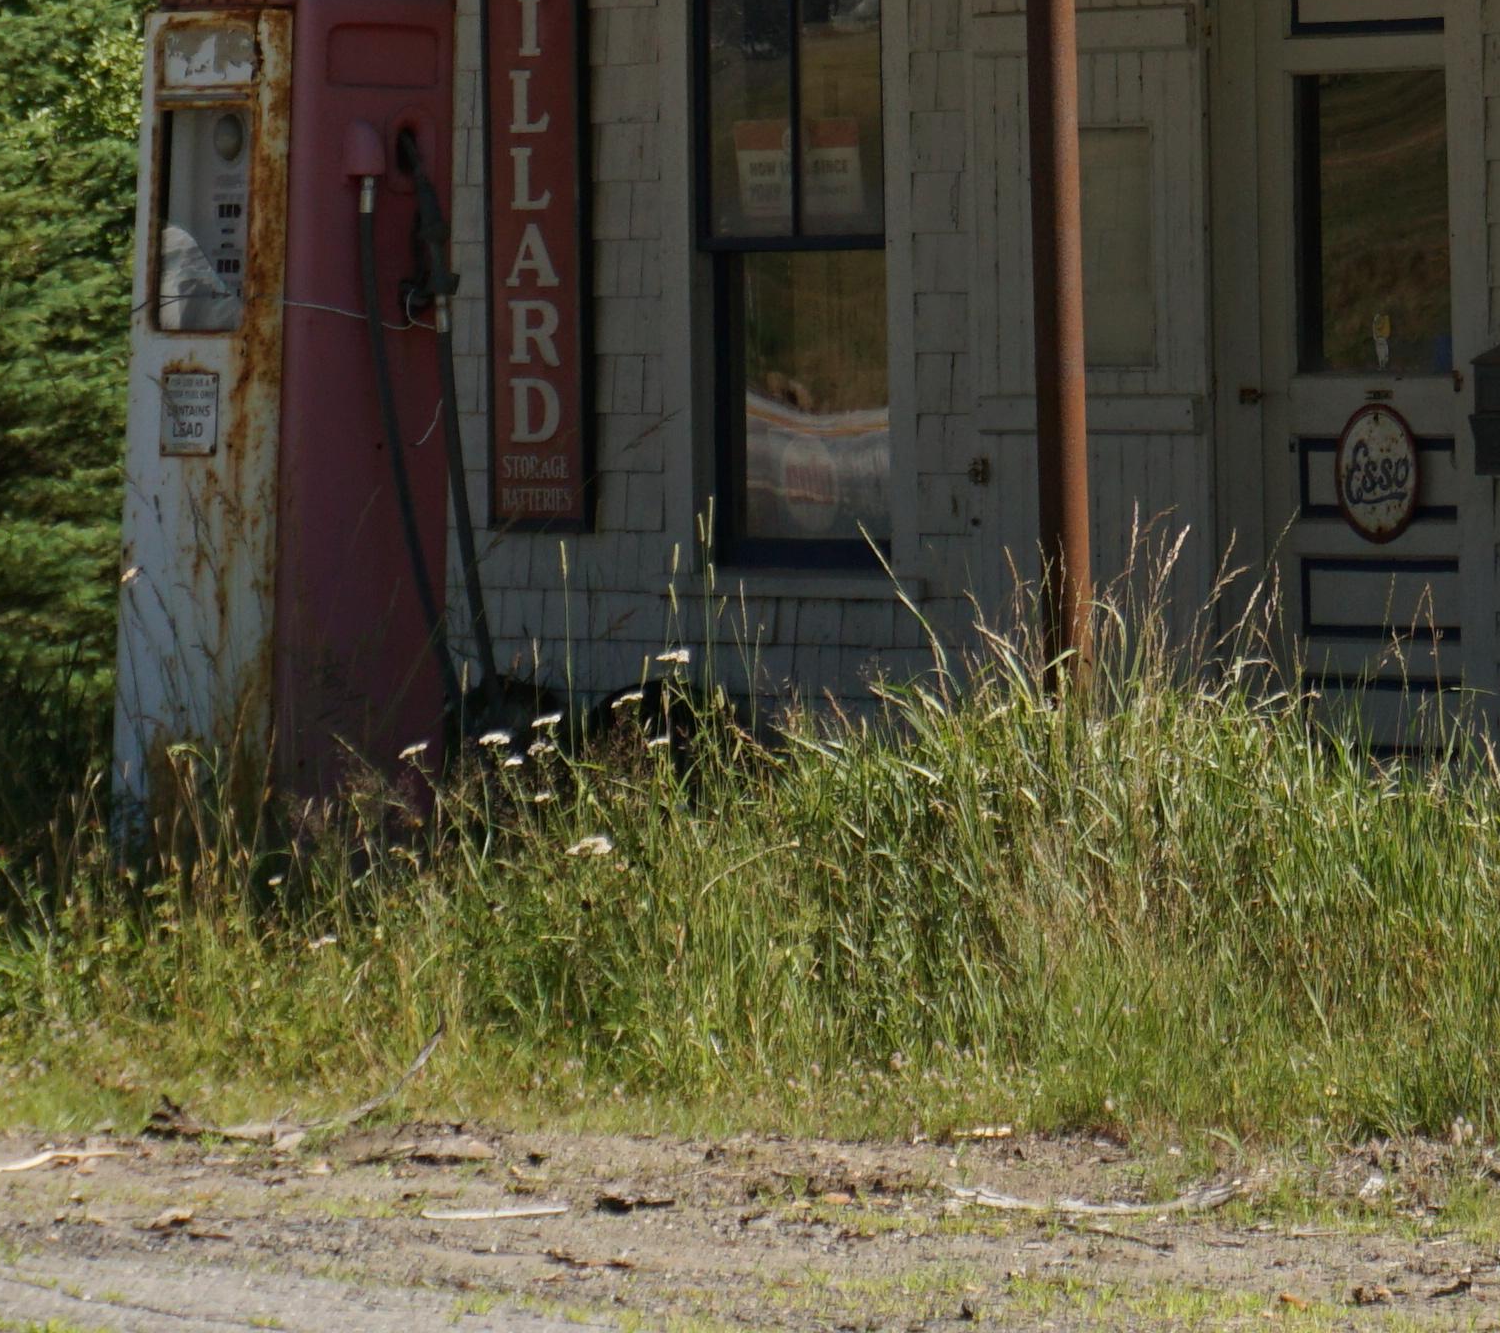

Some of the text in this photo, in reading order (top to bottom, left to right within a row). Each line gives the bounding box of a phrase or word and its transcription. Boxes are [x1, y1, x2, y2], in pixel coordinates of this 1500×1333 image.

[172, 422, 203, 438] LEAD
[501, 453, 571, 479] STORAGE
[1346, 440, 1409, 504] Esso
[501, 487, 574, 511] BATTERIES
